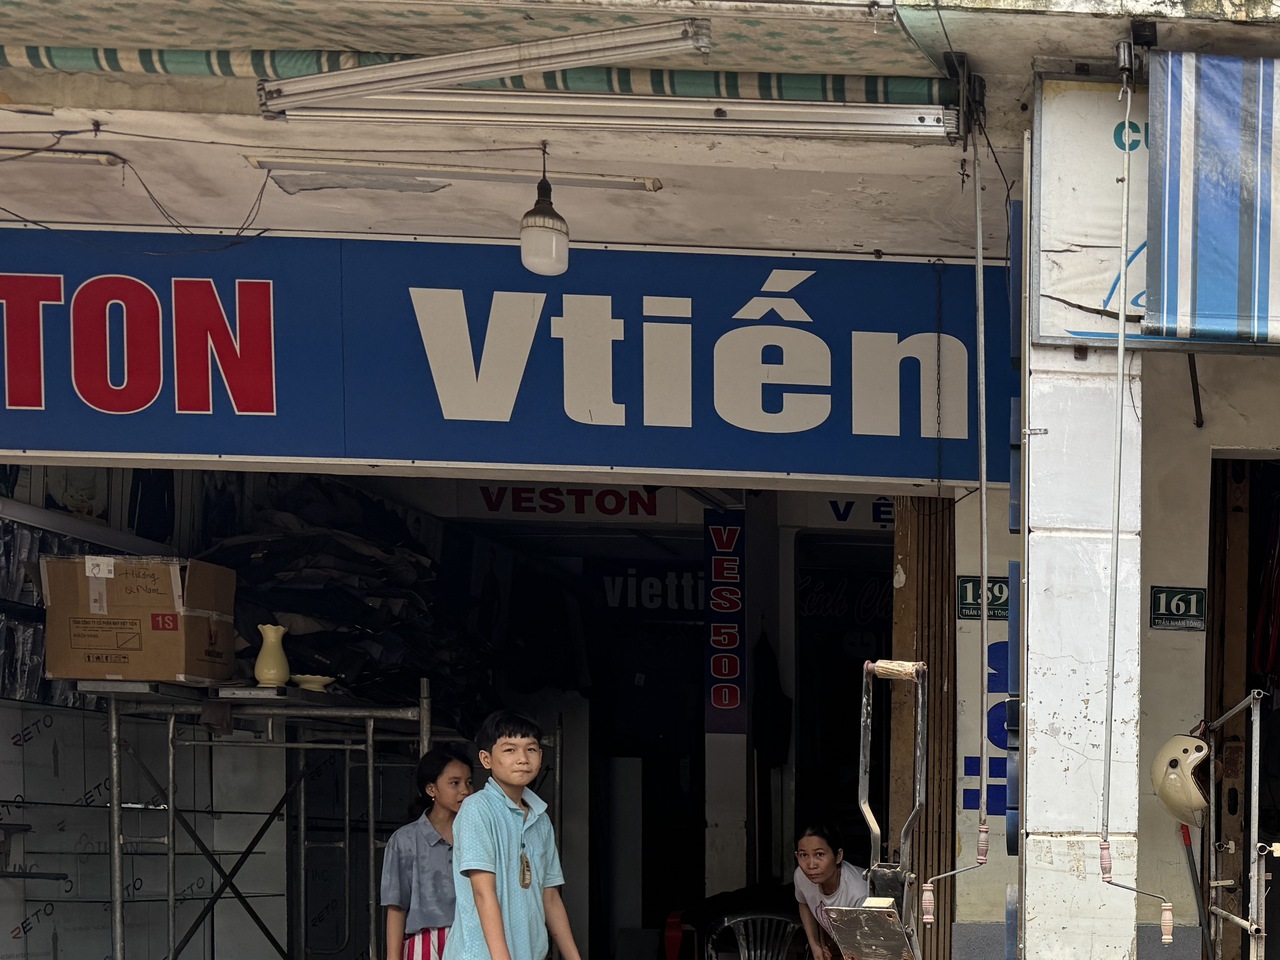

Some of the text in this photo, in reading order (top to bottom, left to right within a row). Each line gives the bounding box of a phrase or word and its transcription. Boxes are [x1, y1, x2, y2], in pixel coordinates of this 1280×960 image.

[409, 269, 968, 439] Vtiến
[479, 486, 657, 516] VESTON
[604, 567, 705, 611] vietti
[1156, 592, 1201, 616] 161
[155, 616, 173, 629] 1S
[709, 624, 741, 709] 500
